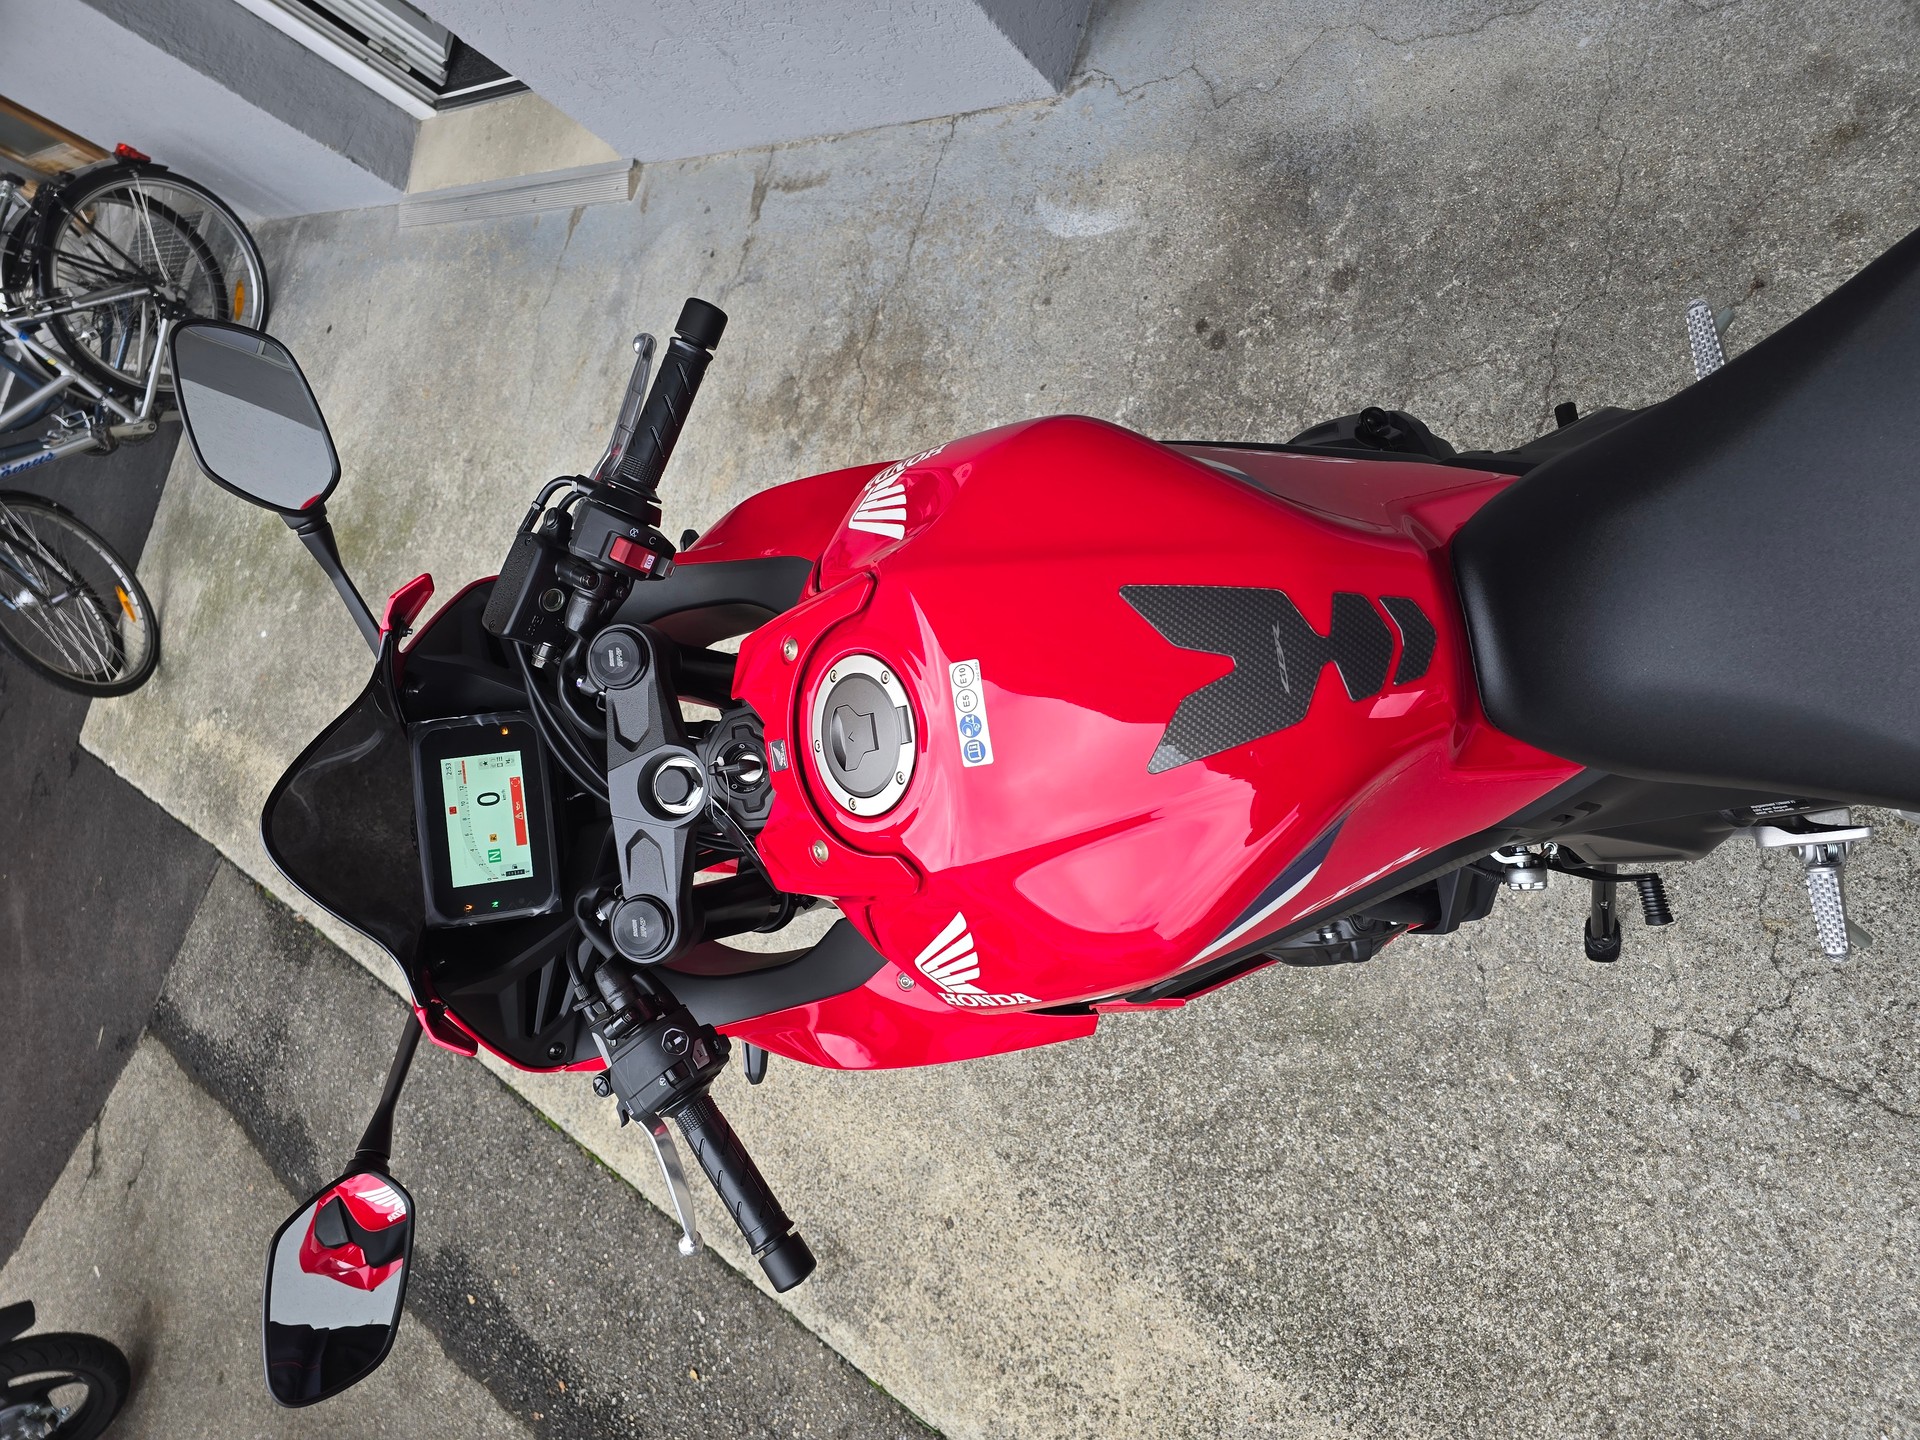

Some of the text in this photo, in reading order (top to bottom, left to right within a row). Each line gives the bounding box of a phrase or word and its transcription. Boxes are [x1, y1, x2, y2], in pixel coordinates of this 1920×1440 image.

[959, 668, 967, 684] E10
[962, 695, 971, 708] E5
[445, 762, 453, 776] 2:53
[477, 792, 500, 806] 0
[490, 850, 501, 861] N
[938, 992, 1042, 1007] HONDA
